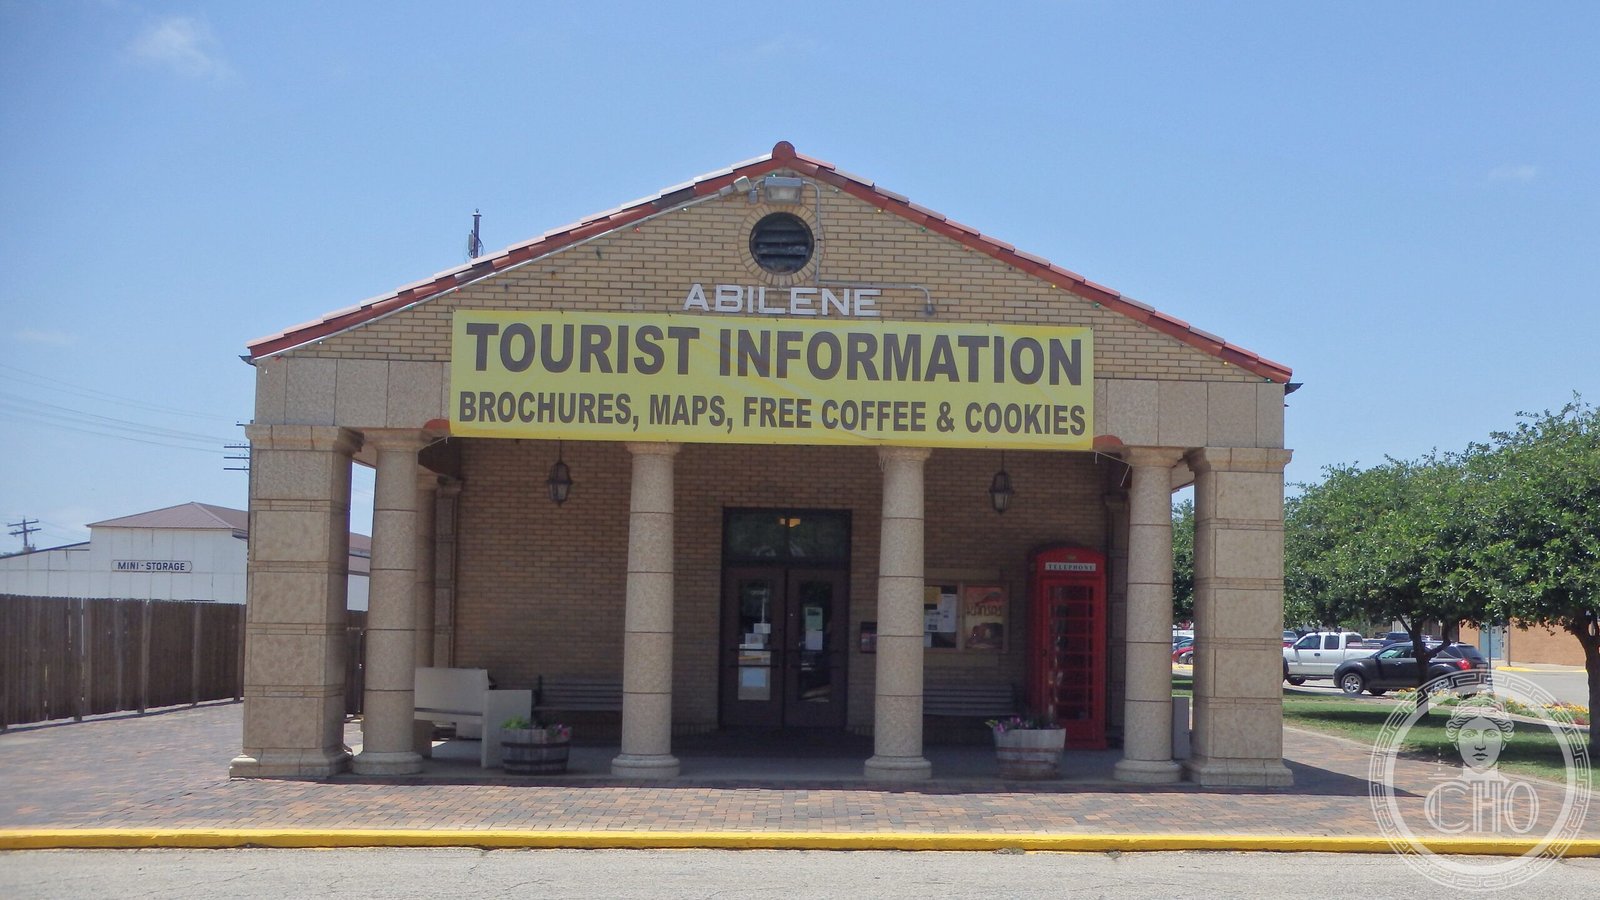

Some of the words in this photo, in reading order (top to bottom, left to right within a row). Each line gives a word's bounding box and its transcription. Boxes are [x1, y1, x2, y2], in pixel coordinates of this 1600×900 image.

[682, 283, 881, 317] ABILENE
[465, 322, 701, 376] TOURIST
[719, 328, 1082, 386] INFORMATION
[459, 390, 639, 433] BROCHURES,
[649, 394, 733, 435] MAPS,
[743, 396, 812, 429] FREE
[821, 399, 927, 433] COFFEE
[936, 401, 956, 433] &
[965, 402, 1086, 437] COOKIES
